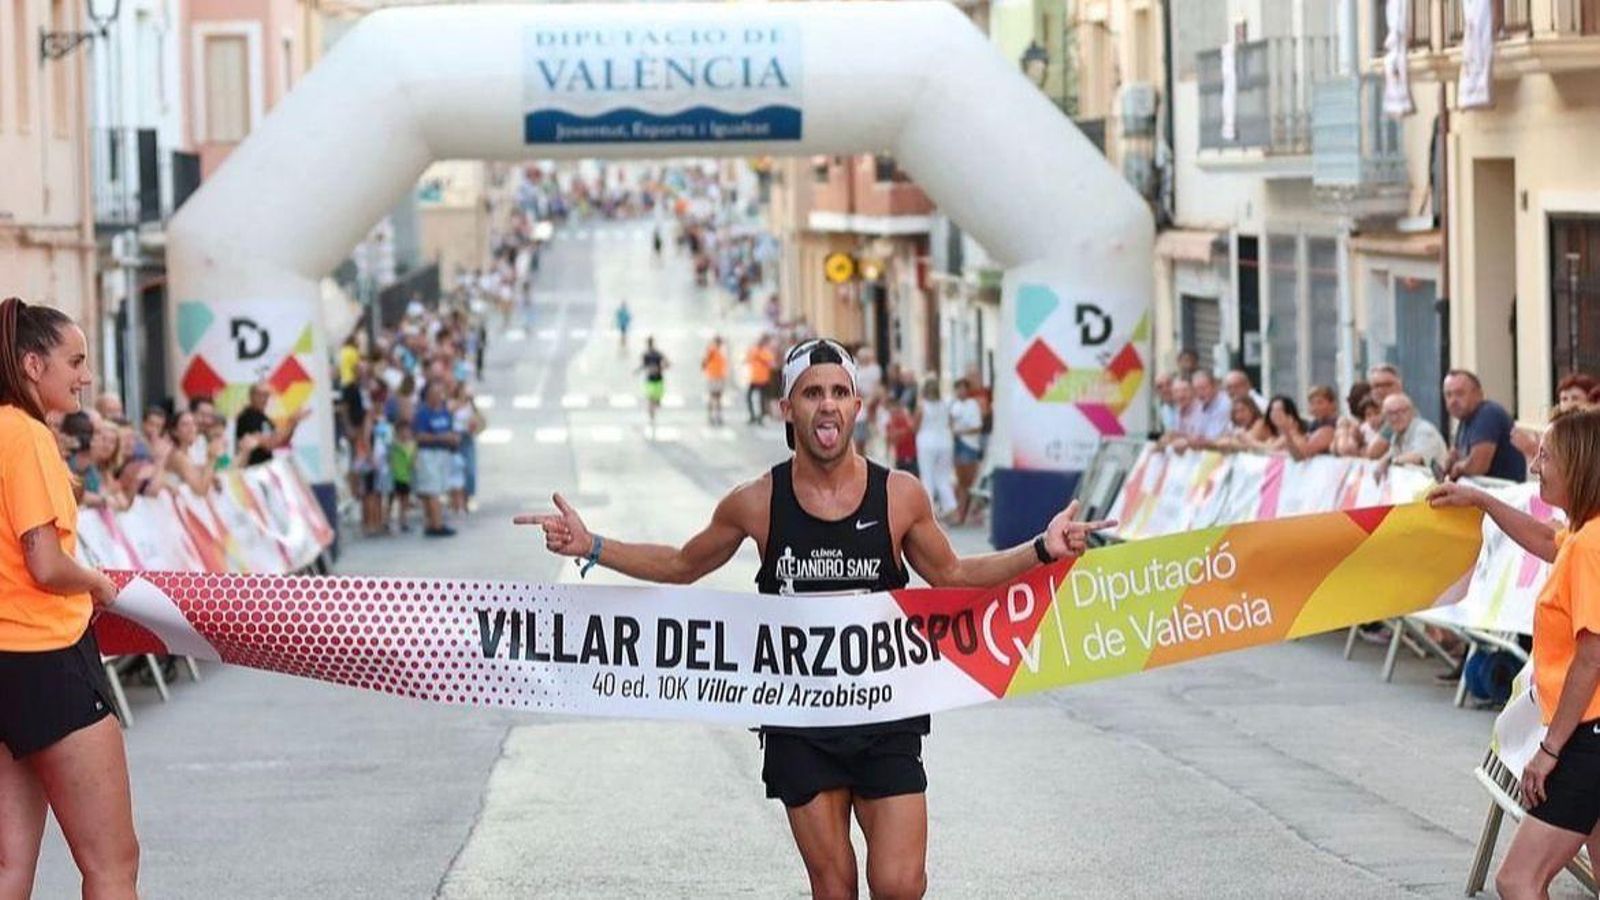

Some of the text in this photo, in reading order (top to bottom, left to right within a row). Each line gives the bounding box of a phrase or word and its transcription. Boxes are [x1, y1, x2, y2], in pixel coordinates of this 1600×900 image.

[743, 27, 786, 44] DE
[536, 51, 790, 91] VALÈNCIA
[810, 548, 843, 558] CLÍNICA
[847, 558, 881, 577] SANZ
[1072, 542, 1238, 610] Diputació
[478, 608, 980, 678] VILLAR DEL ARZOBISPO
[1082, 593, 1273, 663] de València
[591, 671, 893, 710] 40 ed. 10K Villar del Arzobispo
